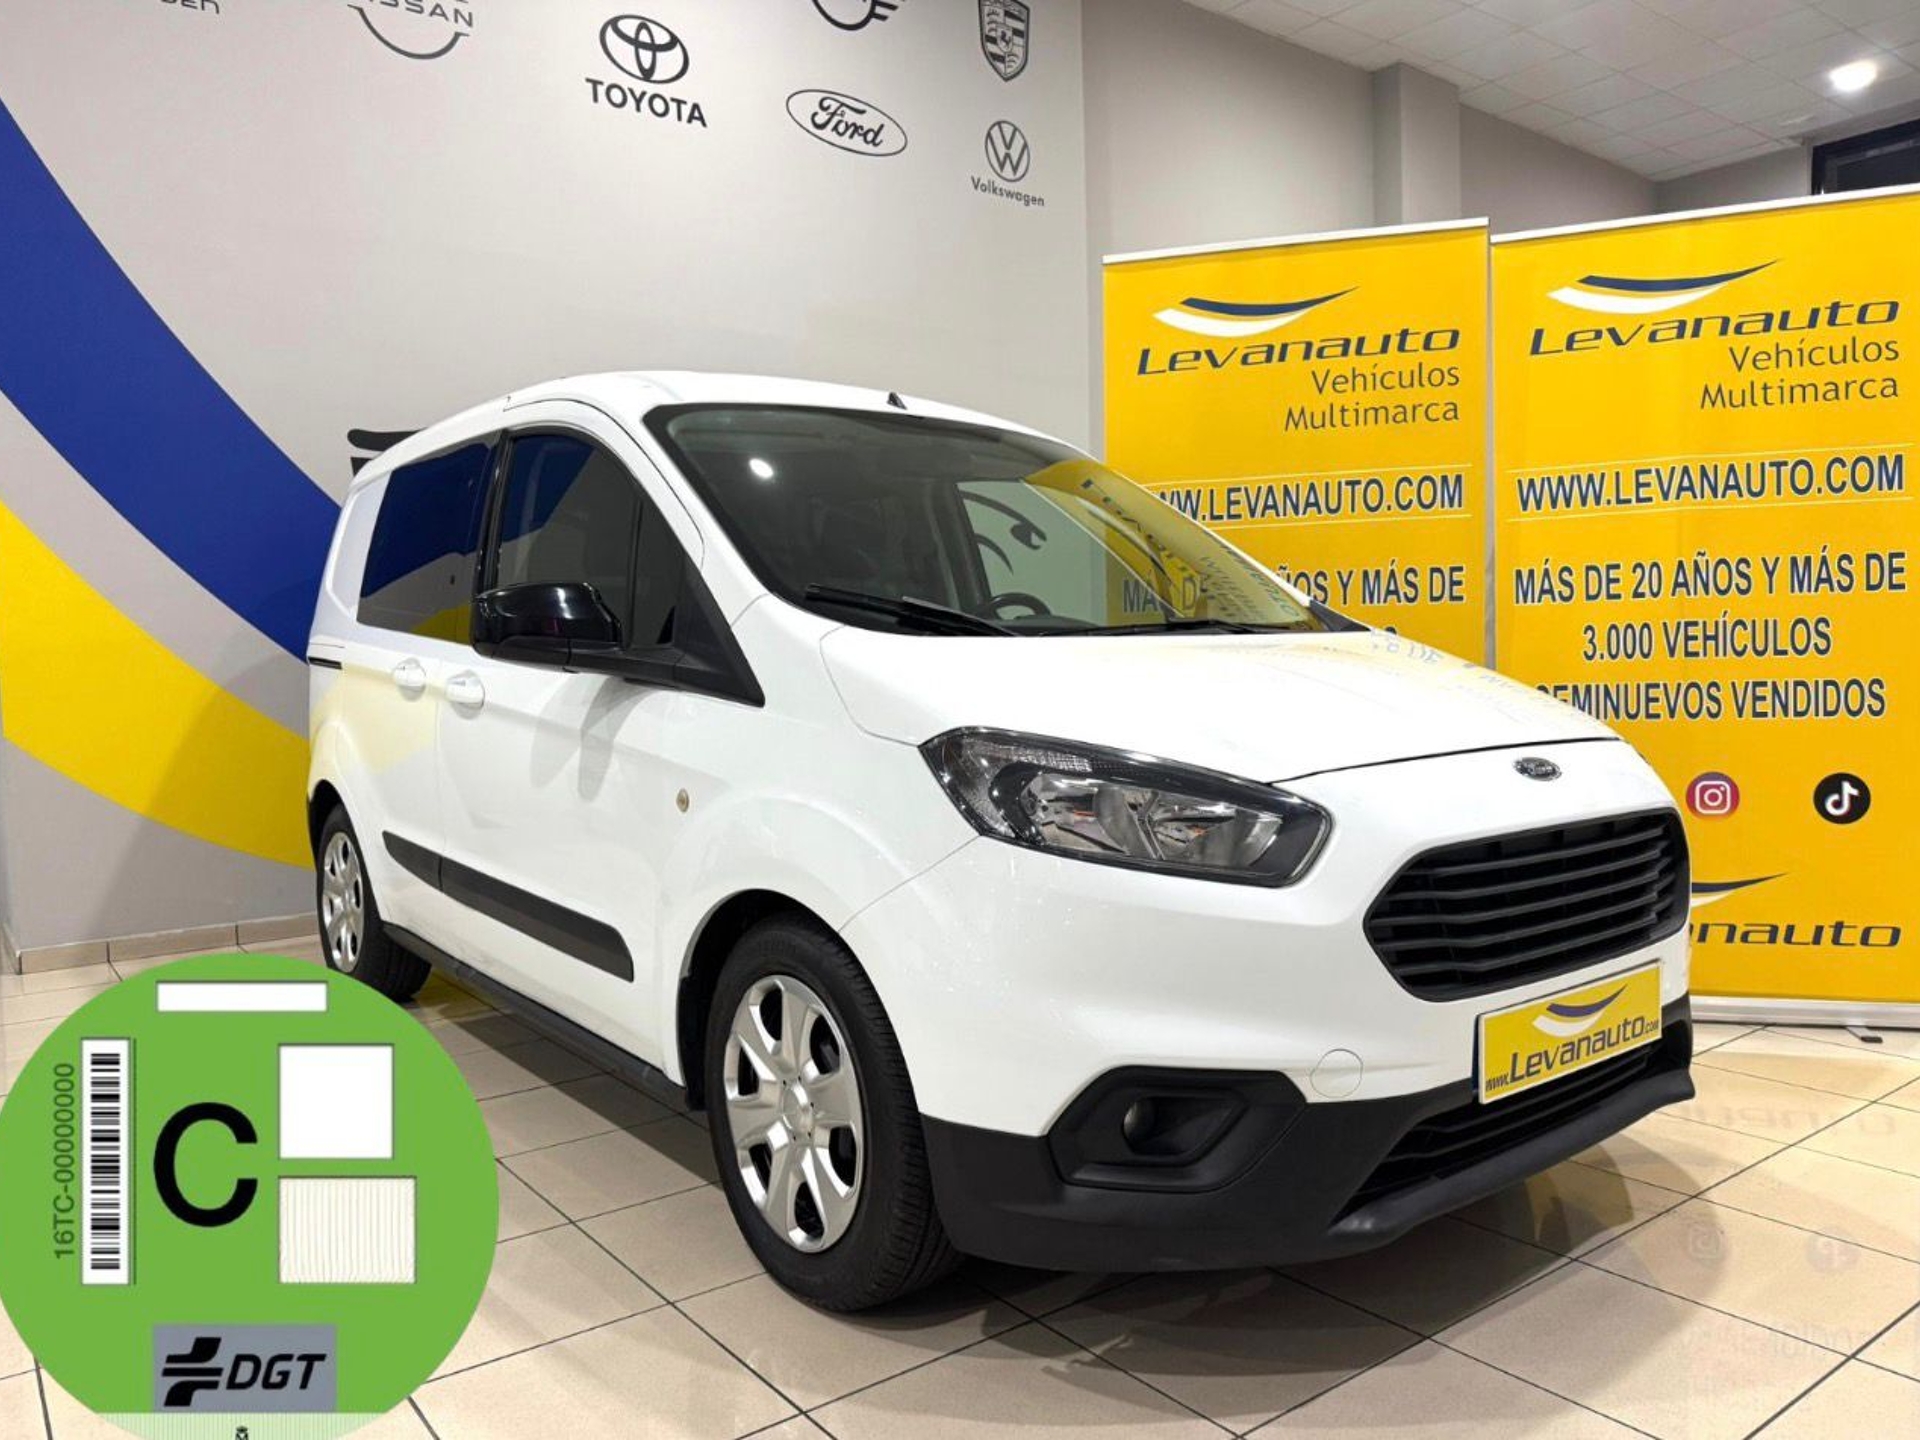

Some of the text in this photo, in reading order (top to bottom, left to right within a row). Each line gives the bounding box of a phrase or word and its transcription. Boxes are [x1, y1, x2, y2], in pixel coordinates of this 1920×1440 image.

[585, 78, 707, 128] TOYOTA
[810, 96, 885, 147] Ford
[971, 175, 1045, 206] Volkswagen
[1136, 327, 1460, 376] Levanauto
[1530, 300, 1899, 356] Levanauto
[1311, 362, 1460, 395] Vehículos
[1729, 337, 1899, 373] Vehículos
[1284, 401, 1460, 432] Multimarca
[1700, 377, 1898, 409] Multimarca
[1159, 474, 1463, 521] W.LEVANAUTO.COM
[1517, 454, 1903, 512] WWW.LEVANAUTO.COM
[1337, 570, 1353, 605] Y
[1362, 559, 1419, 605] MÁS
[1429, 566, 1464, 602] DE
[1515, 546, 1906, 604] MÁS DE 20 AÑOS Y MÁS DE
[1583, 610, 1831, 661] 3.000 VEHÍCULOS
[1731, 678, 1886, 718] VENDIDOS
